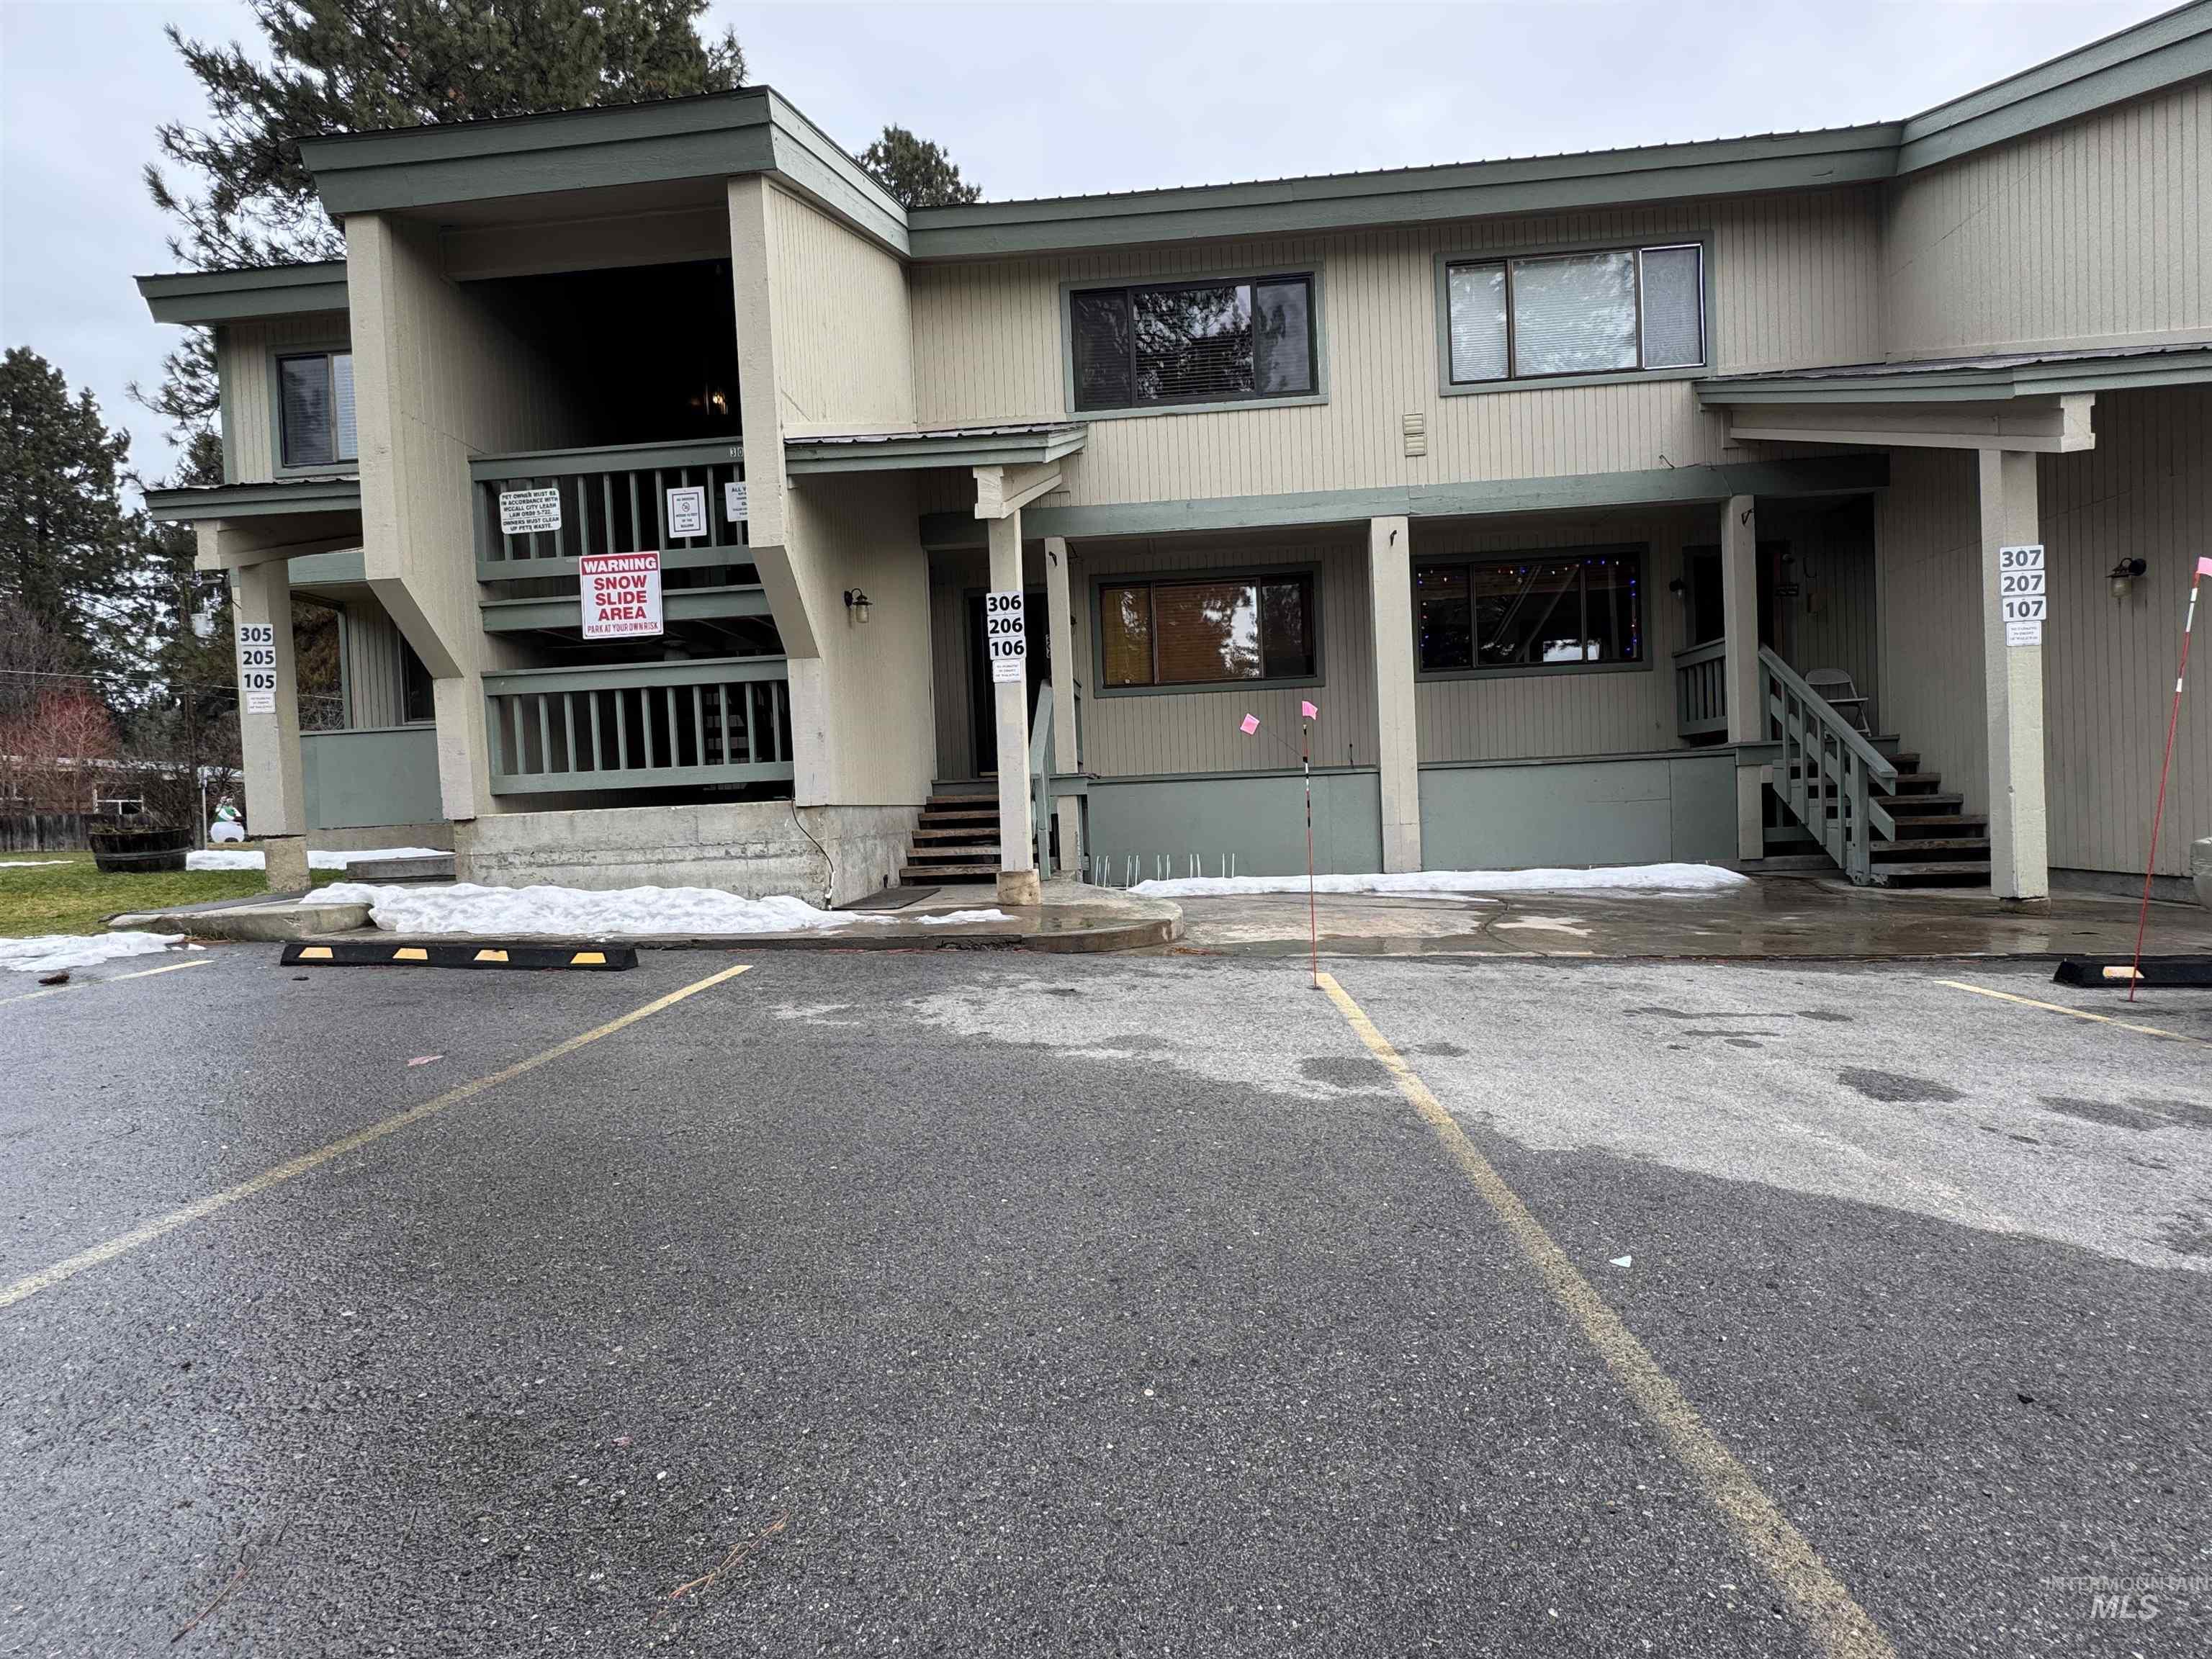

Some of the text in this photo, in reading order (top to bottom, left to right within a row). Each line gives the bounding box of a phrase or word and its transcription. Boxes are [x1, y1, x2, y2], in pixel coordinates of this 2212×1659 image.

[583, 557, 657, 573] WARNING
[2002, 549, 2041, 567] 307
[594, 575, 647, 590] SNOW
[2003, 575, 2043, 592] 207
[595, 590, 647, 606] SLIDE
[988, 595, 1022, 612] 306
[598, 606, 647, 621] AREA
[2005, 601, 2044, 618] 107
[612, 623, 629, 632] YOUR
[629, 622, 644, 631] OWN
[644, 621, 658, 630] RISK
[989, 617, 1023, 634] 206
[240, 627, 271, 642] 305
[992, 639, 1025, 656] 106
[243, 650, 274, 665] 205
[244, 674, 274, 688] 105
